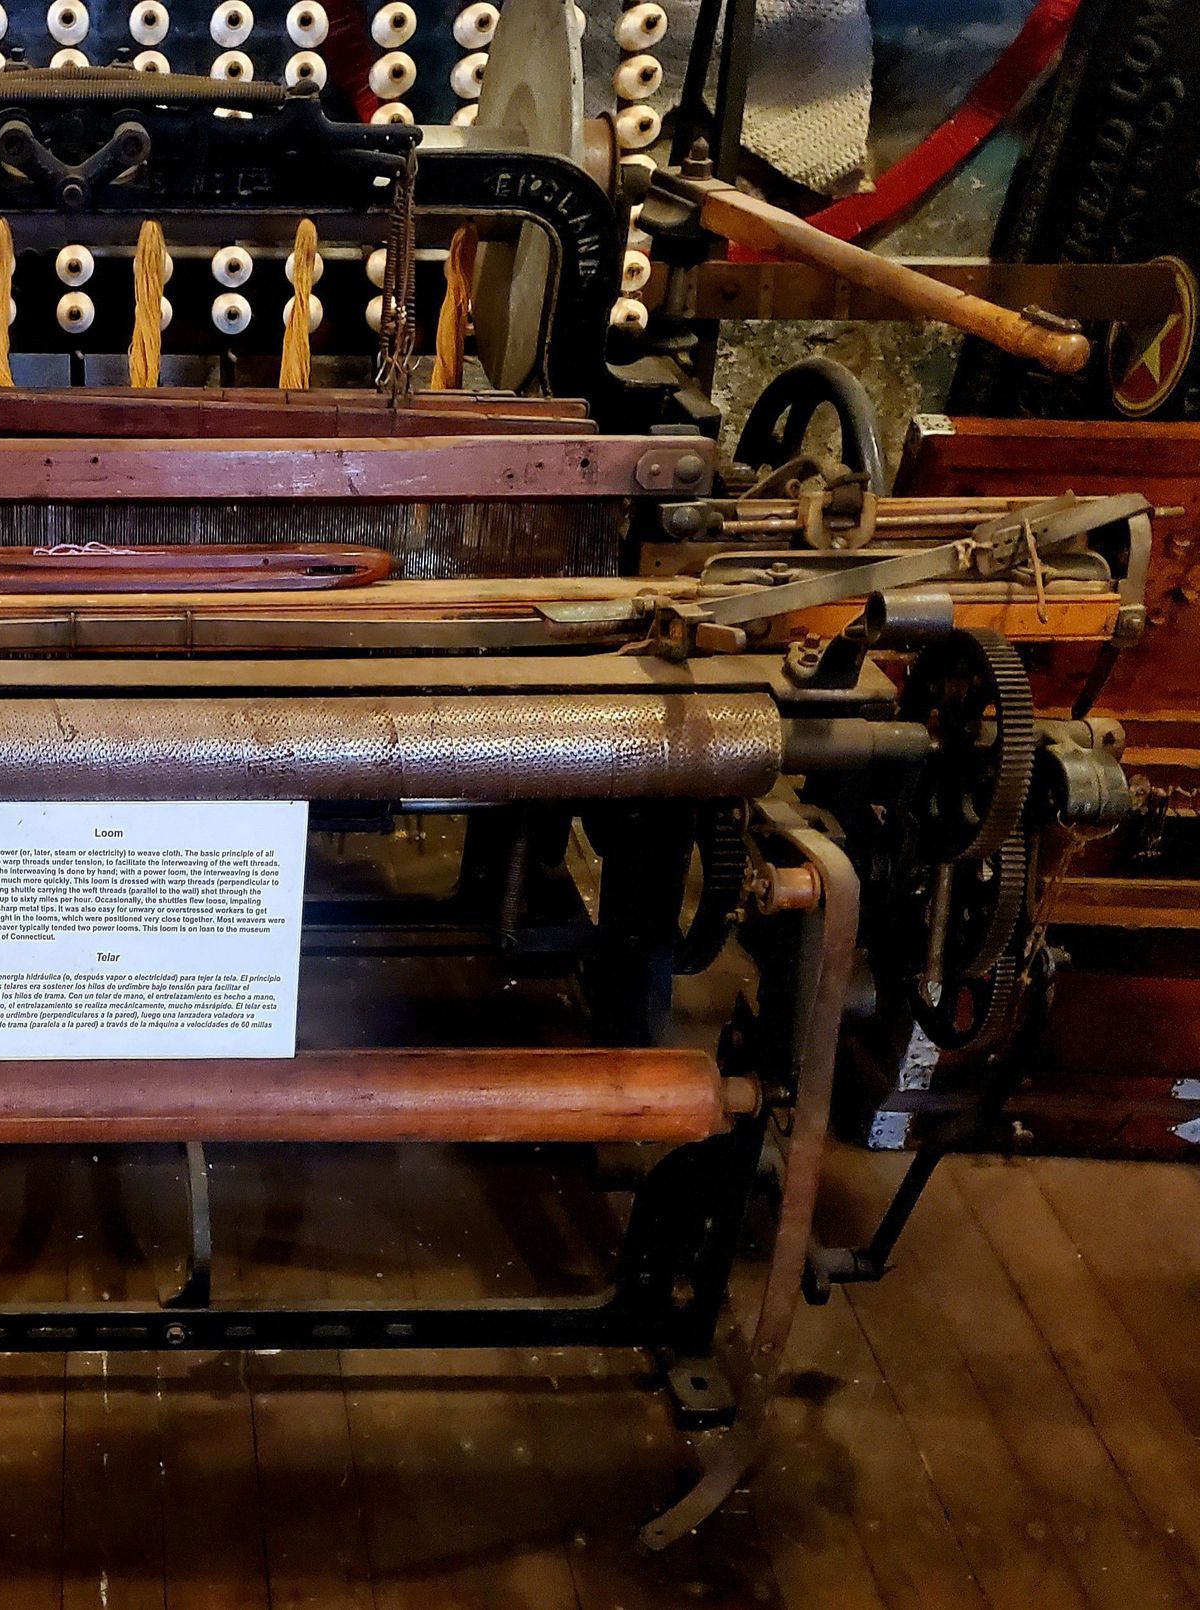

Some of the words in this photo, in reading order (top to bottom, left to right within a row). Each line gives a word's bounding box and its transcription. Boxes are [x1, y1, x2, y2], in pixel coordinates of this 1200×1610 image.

[94, 828, 124, 838] Loom
[19, 848, 32, 858] (or,
[34, 848, 52, 857] later,
[54, 848, 76, 856] steam
[88, 849, 126, 858] electricity)
[221, 849, 254, 858] principle
[255, 849, 264, 857] of
[265, 849, 274, 857] all
[2, 859, 21, 867] warp
[74, 858, 104, 867] tension,
[106, 858, 113, 866] to
[115, 858, 146, 866] facilitate
[148, 858, 159, 866] the
[161, 859, 208, 868] interweaving
[9, 867, 56, 876] interweaving
[58, 867, 64, 875] is
[66, 867, 85, 875] done
[86, 868, 96, 877] by
[97, 868, 118, 876] hand;
[143, 869, 166, 877] power
[168, 868, 188, 877] loom,
[190, 868, 202, 876] the
[203, 868, 250, 878] interweaving
[252, 868, 258, 876] is
[37, 886, 67, 896] carrying
[68, 886, 80, 894] the
[82, 886, 98, 894] weft
[128, 887, 158, 896] (parallel
[182, 887, 199, 896] wall)
[201, 887, 217, 895] shot
[219, 888, 248, 897] through
[13, 914, 21, 922] in
[22, 914, 34, 922] the
[35, 914, 60, 923] looms,
[104, 915, 142, 924] positioned
[143, 916, 160, 924] very
[182, 915, 215, 925] together.
[19, 924, 49, 933] typically
[92, 925, 115, 933] power
[116, 924, 140, 932] looms.
[143, 924, 158, 932] This
[1, 932, 9, 940] of
[96, 952, 121, 962] Telar
[3, 982, 28, 990] telares
[151, 983, 167, 992] bajo
[196, 984, 212, 992] para
[242, 983, 249, 991] el
[39, 1011, 99, 1020] (perpendiculares
[141, 1011, 161, 1020] luego
